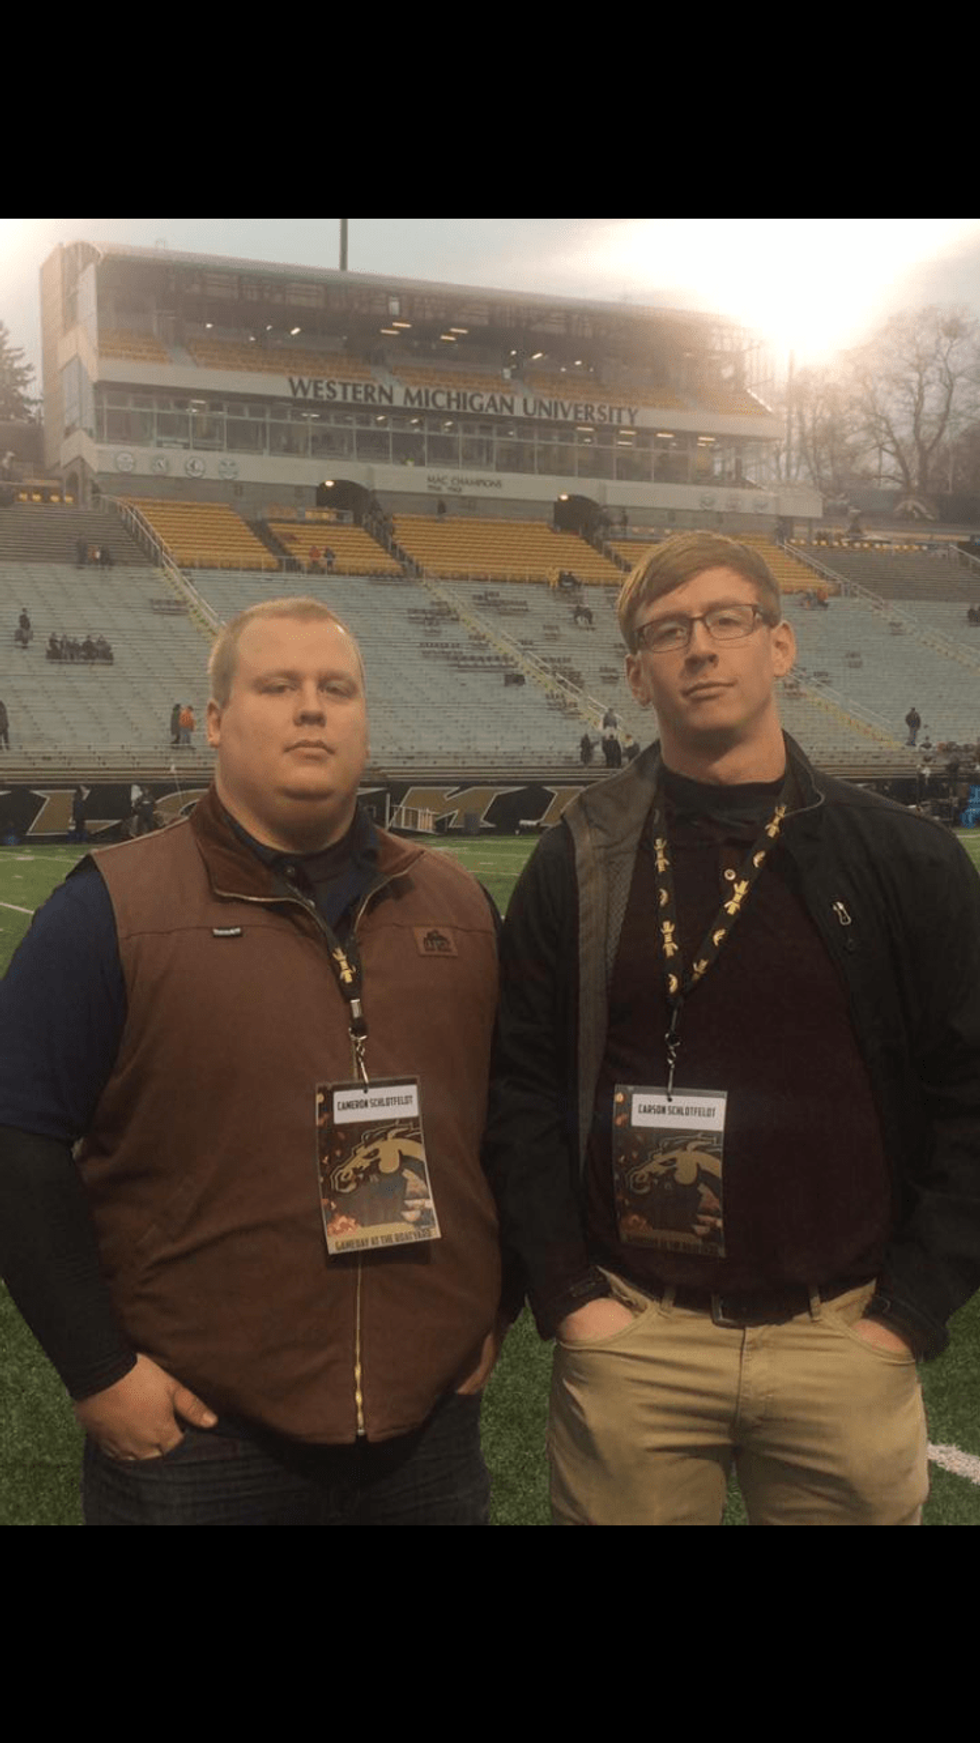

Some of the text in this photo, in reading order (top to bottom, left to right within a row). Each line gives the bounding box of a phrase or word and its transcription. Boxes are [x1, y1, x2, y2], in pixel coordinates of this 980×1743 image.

[289, 376, 638, 424] WESTERN MICHIGAN UNIVERSITY
[337, 1099, 369, 1111] CAMERON
[638, 1103, 716, 1118] CARSON SCHLOTFELDT
